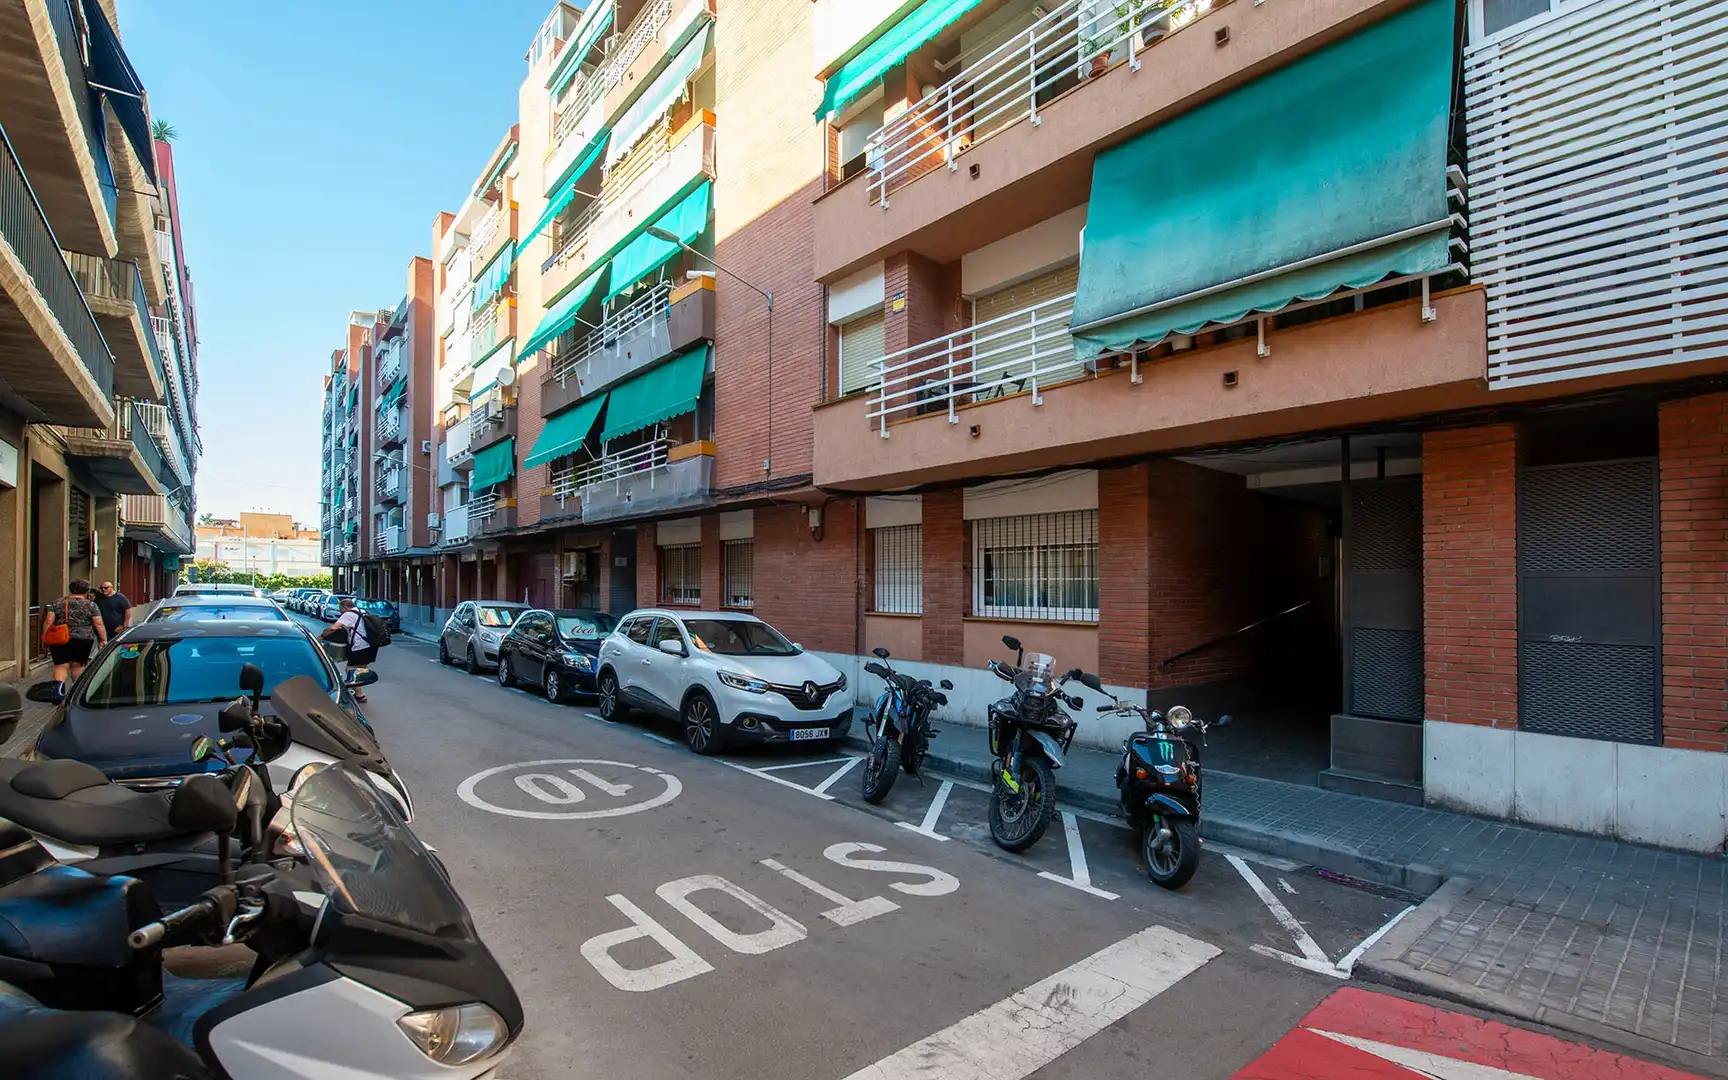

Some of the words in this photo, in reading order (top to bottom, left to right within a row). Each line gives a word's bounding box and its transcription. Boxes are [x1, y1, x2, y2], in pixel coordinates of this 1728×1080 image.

[795, 730, 814, 739] 8056
[514, 768, 633, 804] 10
[580, 842, 960, 992] STOP
